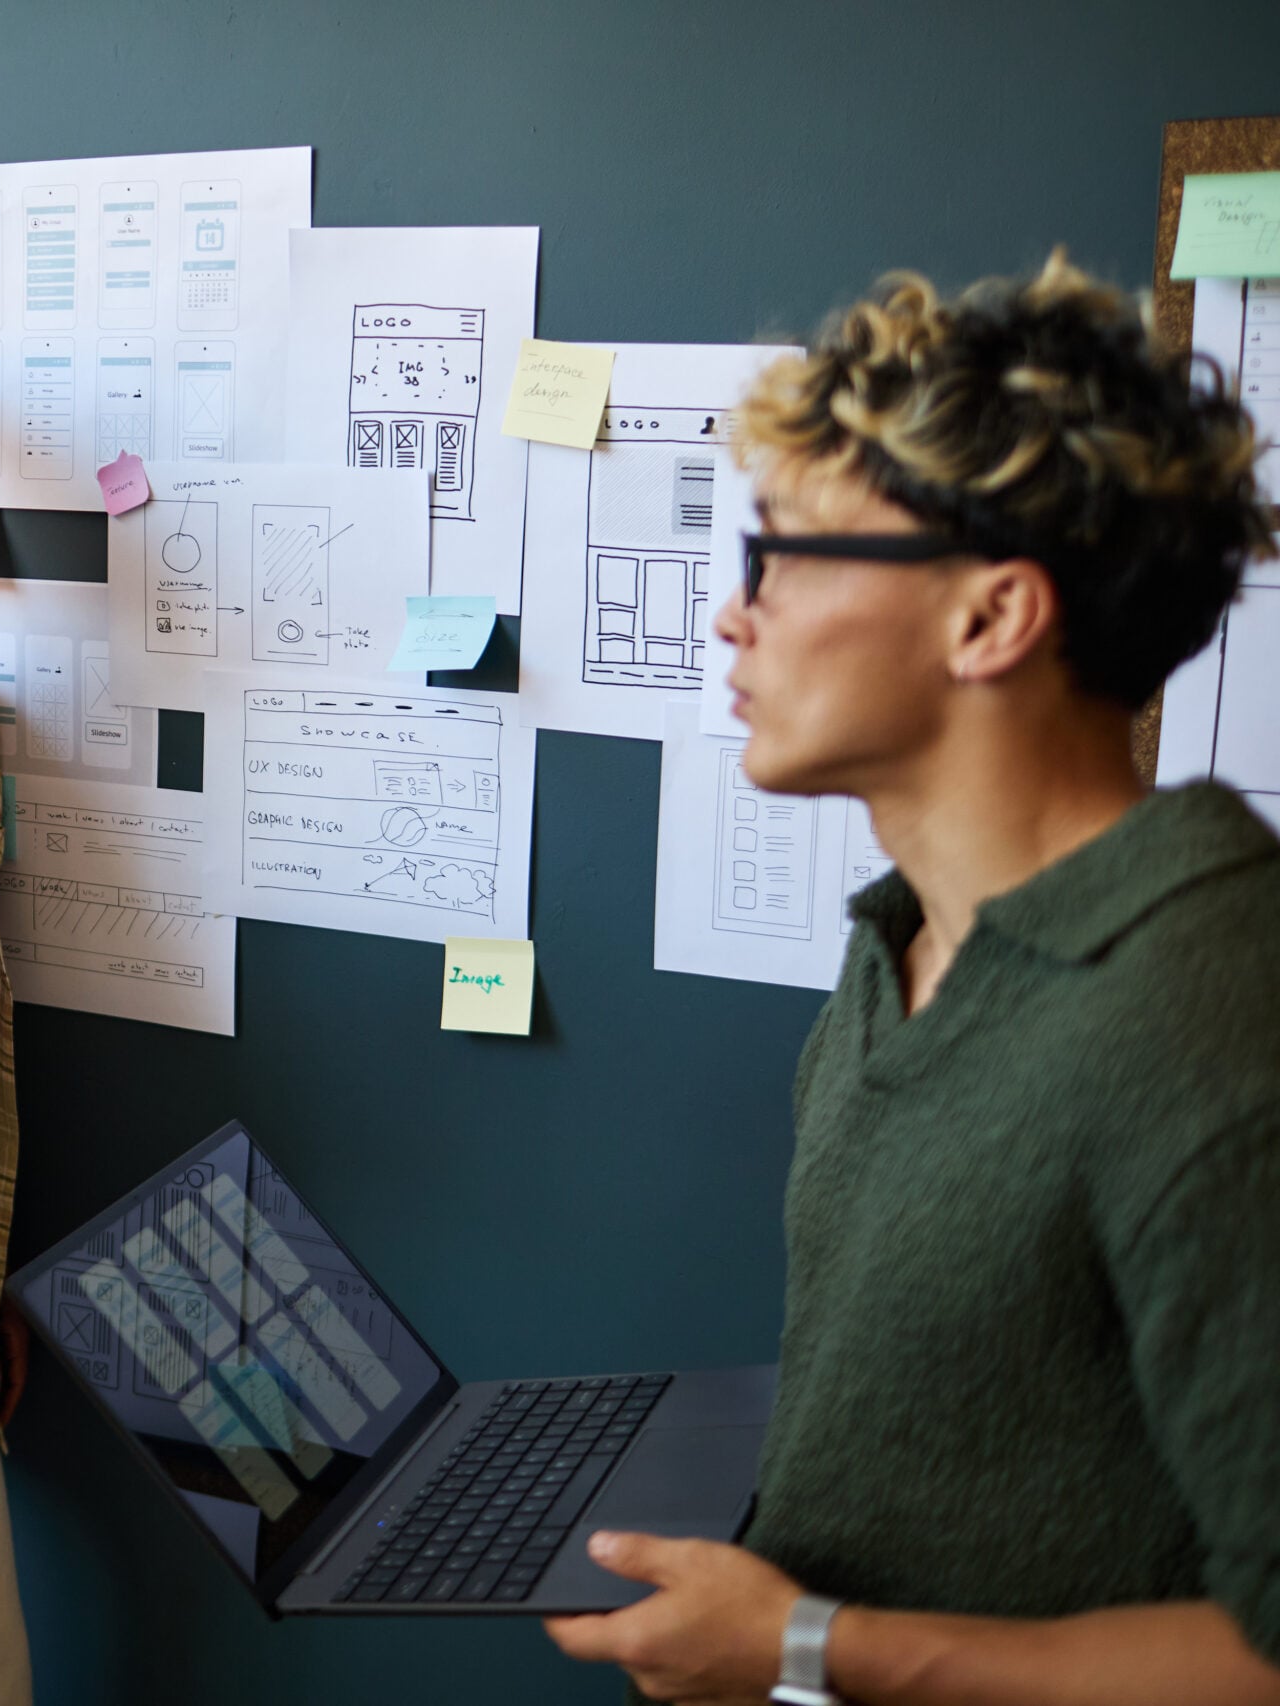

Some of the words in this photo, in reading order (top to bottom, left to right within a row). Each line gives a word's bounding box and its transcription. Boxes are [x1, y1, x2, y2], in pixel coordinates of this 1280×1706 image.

[361, 317, 412, 328] LOGO
[398, 361, 424, 374] IMG
[404, 376, 420, 387] 38
[107, 391, 128, 399] Gallery
[605, 419, 660, 430] LOGO
[188, 444, 218, 452] Slideshow
[90, 729, 121, 738] Slideshow
[248, 760, 270, 774] UX
[278, 762, 324, 779] DESIGN
[248, 810, 294, 828] GRAPHIC
[301, 816, 343, 833] DESIGN
[448, 966, 505, 994] Image
